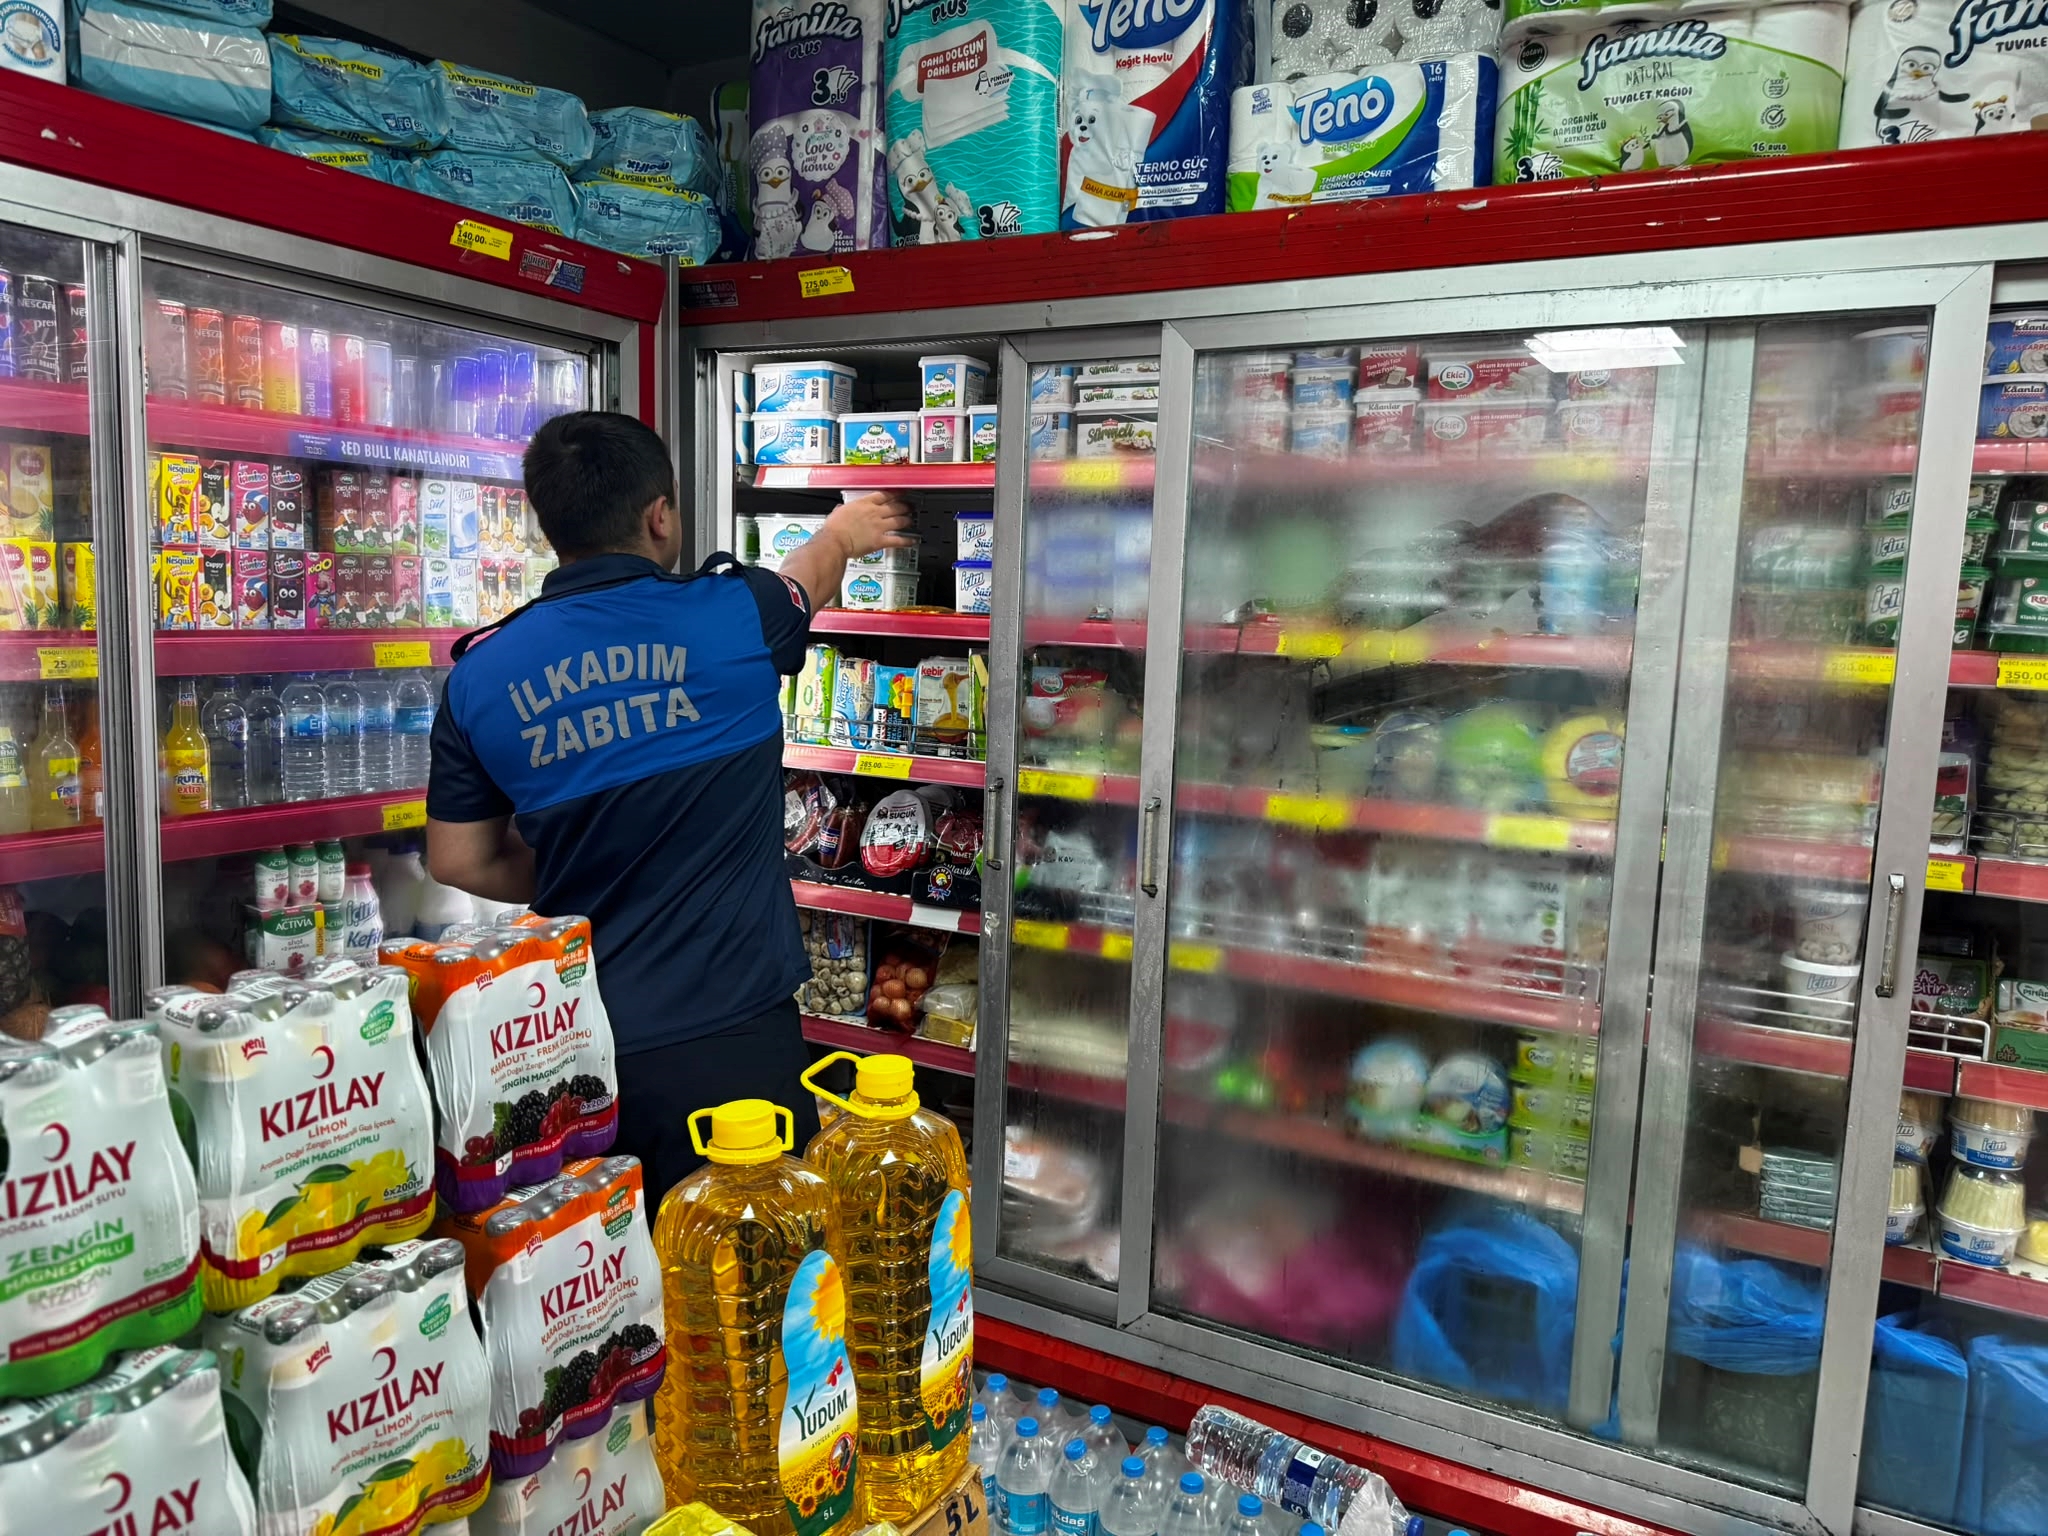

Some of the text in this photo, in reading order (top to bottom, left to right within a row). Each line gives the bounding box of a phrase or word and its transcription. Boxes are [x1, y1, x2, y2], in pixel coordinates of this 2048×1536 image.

[932, 0, 968, 23] PLUS
[755, 5, 861, 63] familia
[789, 41, 821, 58] PLUS
[1578, 20, 1727, 91] familia
[921, 57, 944, 69] DAHA
[1116, 52, 1173, 69] Kağıt Havlu
[1429, 64, 1442, 75] 16
[928, 65, 950, 79] DAHA
[813, 69, 848, 104] 3 ply
[1604, 86, 1693, 107] TUVALET KAĞIDI
[1562, 113, 1599, 126] ORGANİK
[1553, 126, 1583, 137] BAMBU
[805, 137, 836, 155] love
[1322, 140, 1377, 153] Toilet Paper
[1752, 142, 1766, 152] 16
[626, 160, 671, 173] molfix
[801, 159, 836, 174] home
[1136, 156, 1209, 174] TERMO GÜÇ
[1516, 157, 1534, 183] 3
[1135, 170, 1200, 183] TEKNOLOJİSİ
[1319, 179, 1367, 190] TECHNOLOGY
[1321, 170, 1392, 184] THERMO POWER
[1085, 183, 1127, 200] DAHA KALIN
[507, 206, 554, 220] molfix
[977, 204, 1022, 237] 3 katlı
[786, 374, 807, 386] Beyaz
[1446, 371, 1466, 379] Ekici
[784, 422, 807, 434] Beyaz
[931, 428, 946, 436] Light
[1087, 423, 1135, 445] Sürmeli
[365, 442, 391, 459] BULL
[394, 446, 470, 469] KANATLANDIRI
[167, 463, 196, 475] Nesquik
[203, 472, 221, 480] Cappy
[165, 555, 195, 565] Nesquik
[205, 561, 224, 569] Cappy
[853, 584, 876, 593] Süzme
[921, 665, 945, 677] kebir
[508, 643, 687, 723] İLKADIM
[835, 673, 850, 709] Kaşar
[519, 687, 702, 769] ZABITA
[177, 785, 201, 794] extra
[889, 809, 917, 820] SUCUK
[950, 850, 972, 859] NAMET
[275, 918, 313, 932] ACTIVIA
[288, 938, 303, 946] shot
[476, 970, 492, 987] yeni
[490, 996, 580, 1060] KIZILAY
[560, 1028, 592, 1046] ÜZÜMÜ
[241, 1036, 267, 1060] yeni
[501, 1075, 530, 1093] ZENGİN
[260, 1071, 386, 1143] KIZILAY
[308, 1117, 348, 1139] LİMON
[305, 1138, 332, 1152] Zengin
[273, 1133, 381, 1180] ZENGİN MAGNEZYUMLU
[383, 1176, 424, 1198] 6x200ml
[52, 1199, 94, 1223] MADEN
[95, 1187, 126, 1204] SUYU
[7, 1216, 125, 1273] ZENGİN
[526, 1231, 543, 1250] yeni
[4, 1239, 127, 1294] MAGNEZYUMLU
[540, 1245, 627, 1327] KIZILAY
[931, 1309, 969, 1364] YUDUM
[305, 1341, 331, 1371] yeni
[552, 1337, 579, 1359] ZENGİN
[327, 1360, 445, 1444] KIZILAY
[791, 1384, 849, 1443] YUDUM
[374, 1411, 414, 1439] LİMON
[341, 1453, 376, 1477] ZENGİN
